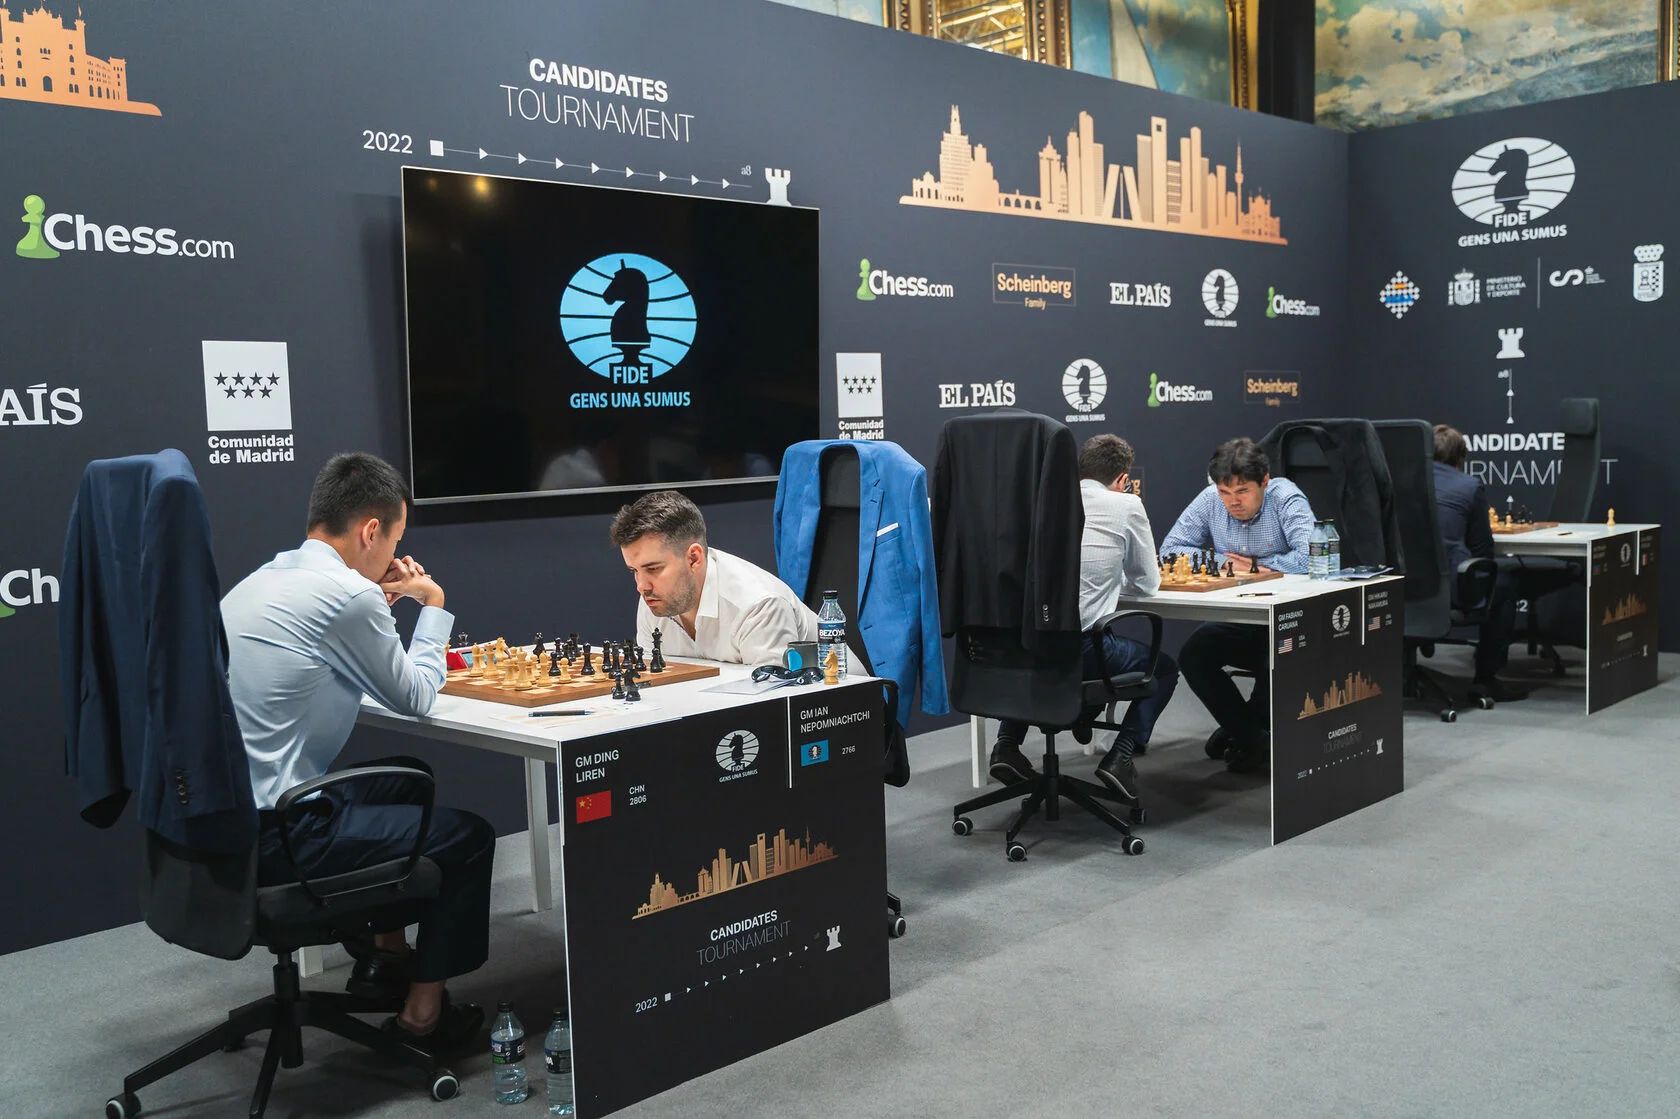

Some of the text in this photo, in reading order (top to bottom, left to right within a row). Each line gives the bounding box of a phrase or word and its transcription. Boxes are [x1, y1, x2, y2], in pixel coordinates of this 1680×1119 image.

[529, 58, 669, 103] CANDIDATES
[500, 84, 695, 143] TOURNAMENT
[362, 129, 413, 154] 2022
[1494, 212, 1528, 228] FIDE
[44, 213, 235, 260] Chess.com
[1458, 224, 1568, 247] GENS UNA SUMUS
[868, 269, 954, 298] Chess.com
[997, 273, 1072, 299] Scheinberg
[1024, 297, 1047, 311] Family
[1109, 282, 1171, 307] EL PAÍS
[613, 366, 649, 385] FIDE
[939, 379, 1016, 408] EL PAÍS
[1155, 380, 1213, 402] Chess.com
[1247, 378, 1298, 398] Scheinberg
[0, 382, 83, 427] AÍS
[569, 391, 691, 409] GENS UNA SUMUS
[838, 419, 885, 430] Comunidad
[838, 428, 885, 440] de Madrid
[208, 434, 294, 449] Comunidad
[1462, 432, 1566, 452] ANDIDATE
[209, 447, 295, 464] de Madrid
[819, 628, 845, 637] BEZOYA
[800, 705, 829, 721] GM IAN
[800, 710, 871, 734] NEPOMNIACHTCHI
[575, 749, 620, 768] GM DING
[576, 767, 606, 783] LIREN
[629, 784, 646, 795] CHN
[629, 794, 647, 806] 2806
[709, 909, 778, 942] CANDIDATES
[696, 919, 791, 965] TOURNAMENT
[635, 996, 658, 1014] 2022
